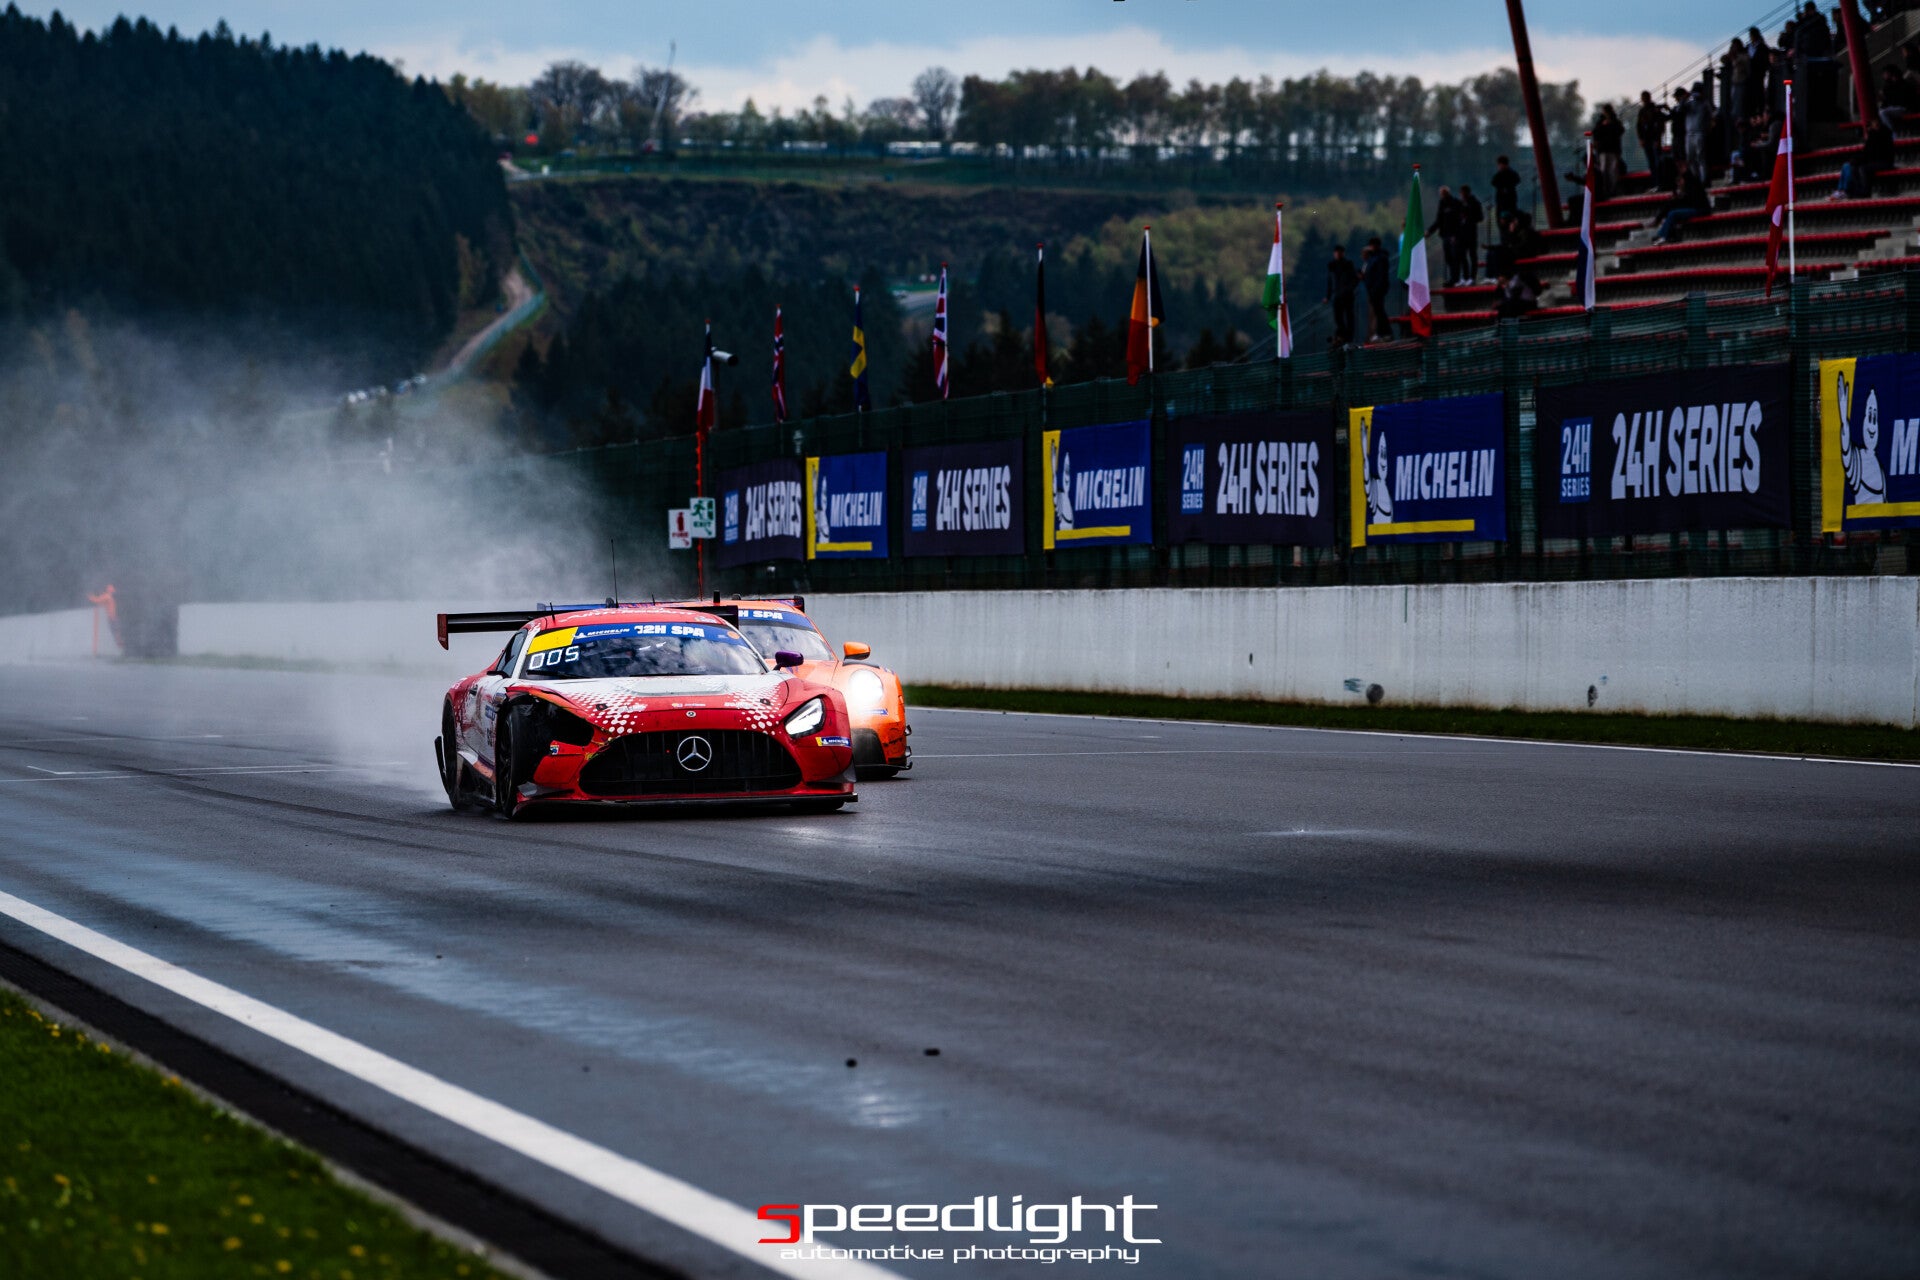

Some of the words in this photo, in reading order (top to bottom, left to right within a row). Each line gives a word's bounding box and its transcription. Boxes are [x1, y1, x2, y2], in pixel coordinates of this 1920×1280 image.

[1183, 449, 1204, 490] 24H
[1562, 423, 1591, 475] 24H
[1611, 410, 1663, 500] 24H
[1665, 400, 1763, 498] SERIES
[1889, 418, 1920, 475] M
[936, 469, 962, 531] 24H
[962, 464, 1011, 531] SERIES
[1075, 466, 1146, 511] MICHELIN
[1216, 442, 1253, 514] 24H
[1254, 440, 1320, 518] SERIES
[1395, 449, 1496, 501] MICHELIN
[1561, 476, 1590, 498] SERIES
[745, 485, 767, 541] 24H
[767, 480, 802, 539] SERIES
[829, 491, 883, 528] MICHELIN
[634, 625, 667, 635] 12H
[671, 625, 705, 637] SPA
[752, 610, 784, 620] SPA
